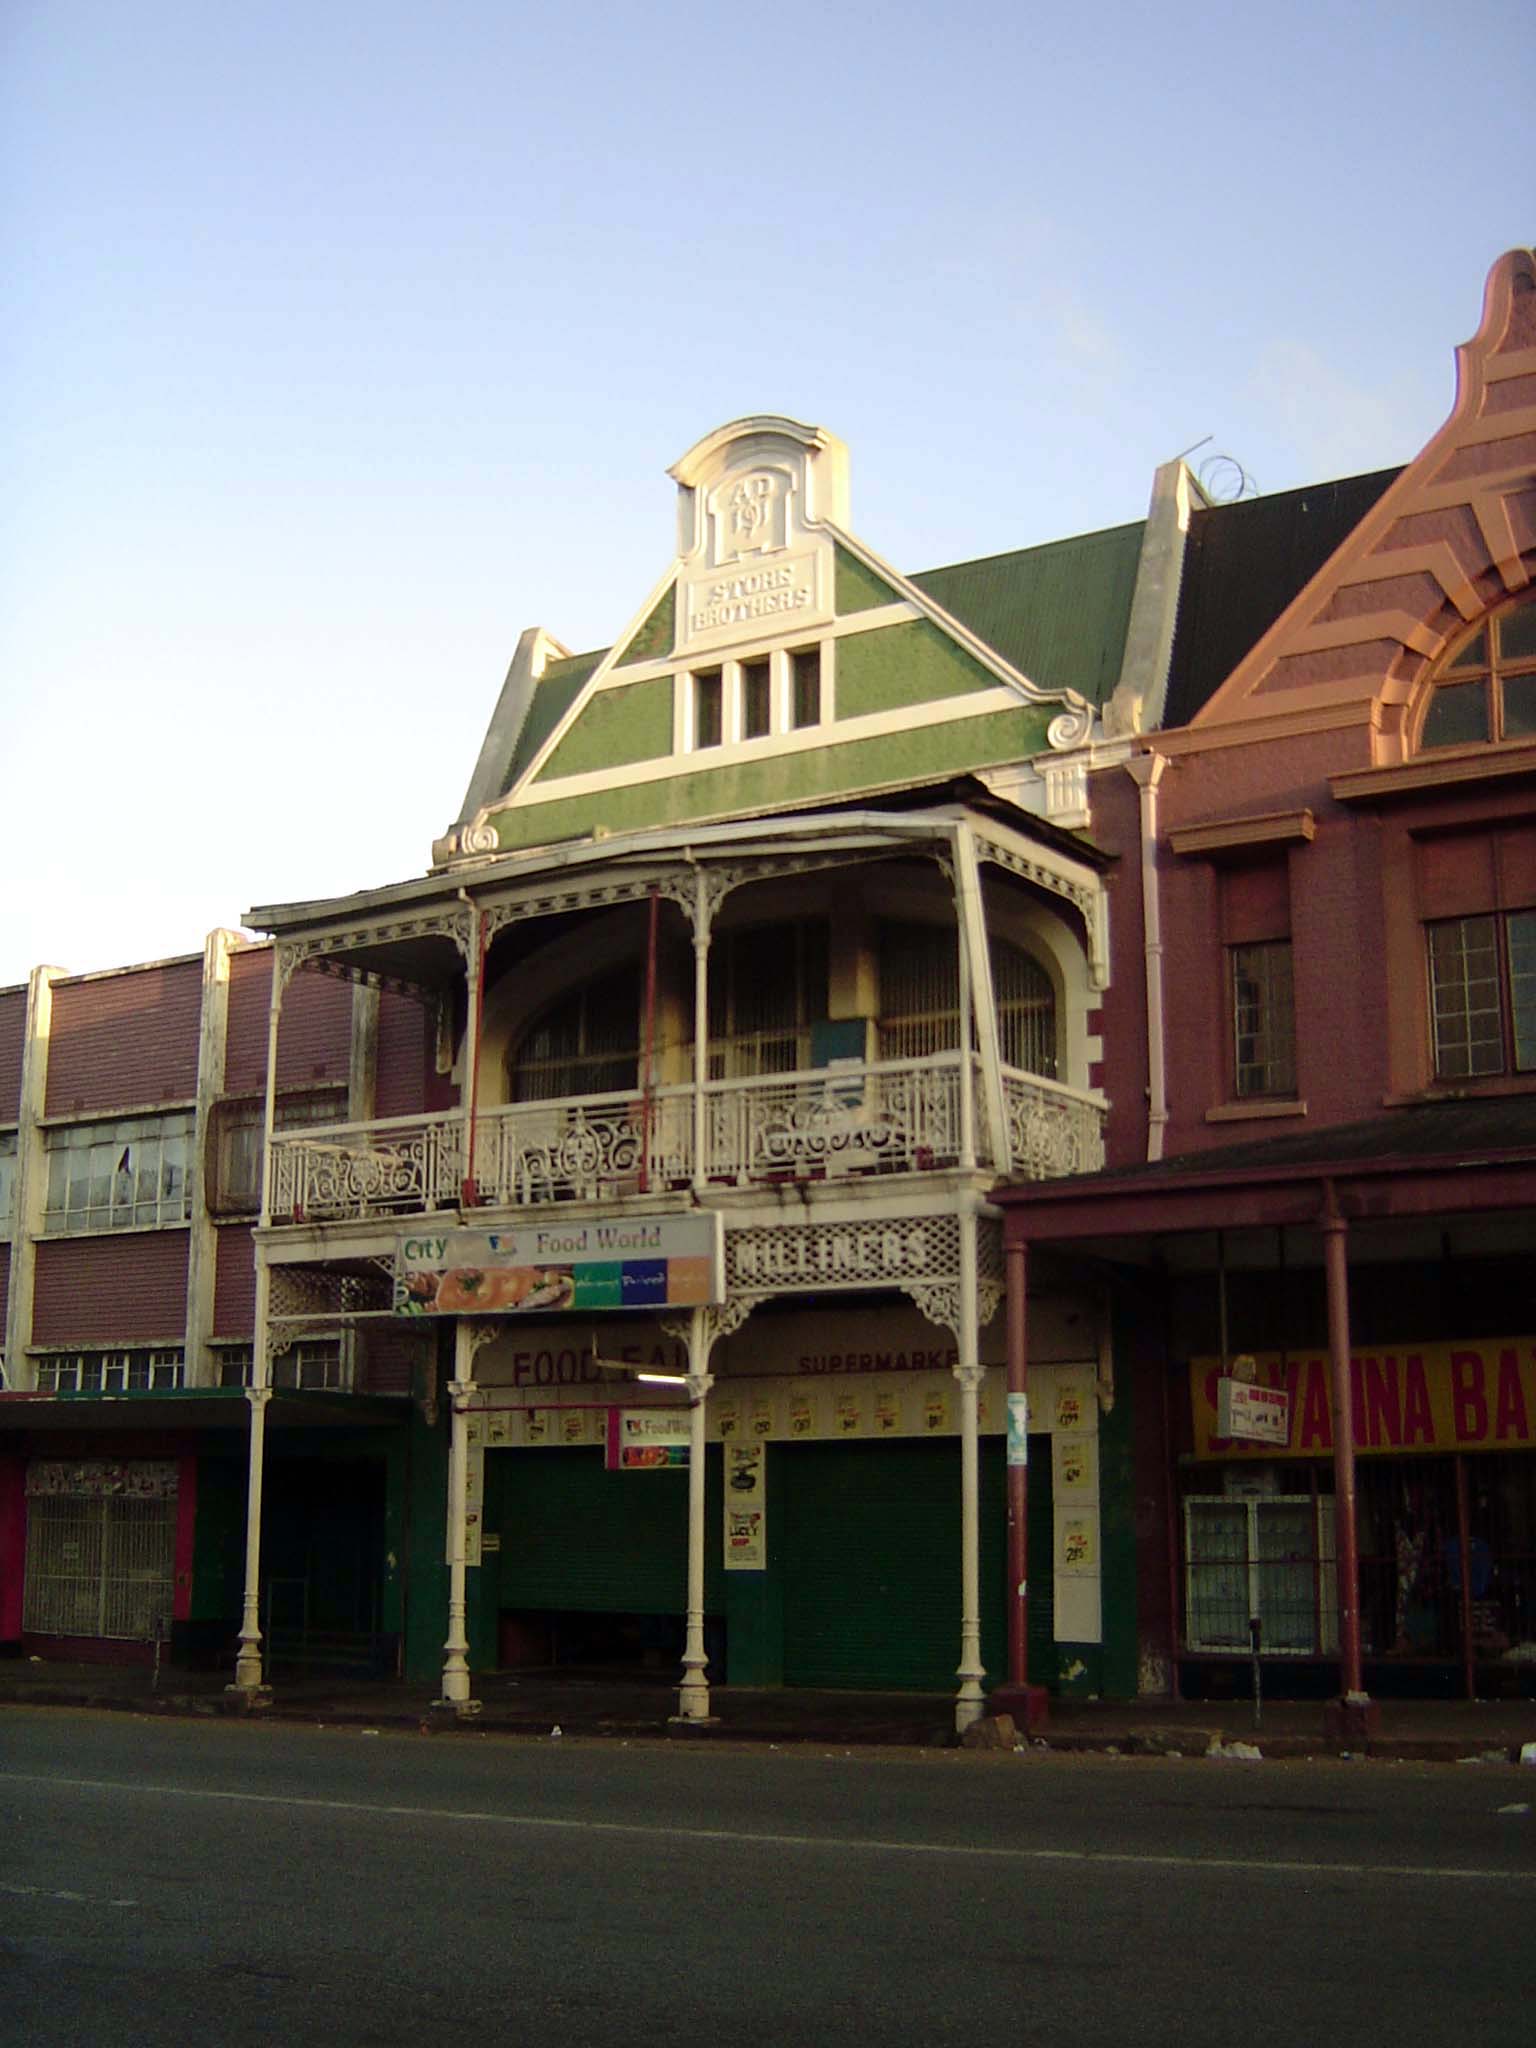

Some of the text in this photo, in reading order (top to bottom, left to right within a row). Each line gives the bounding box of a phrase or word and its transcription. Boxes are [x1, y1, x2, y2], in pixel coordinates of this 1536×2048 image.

[404, 1237, 448, 1262] City
[536, 1226, 661, 1255] Food World
